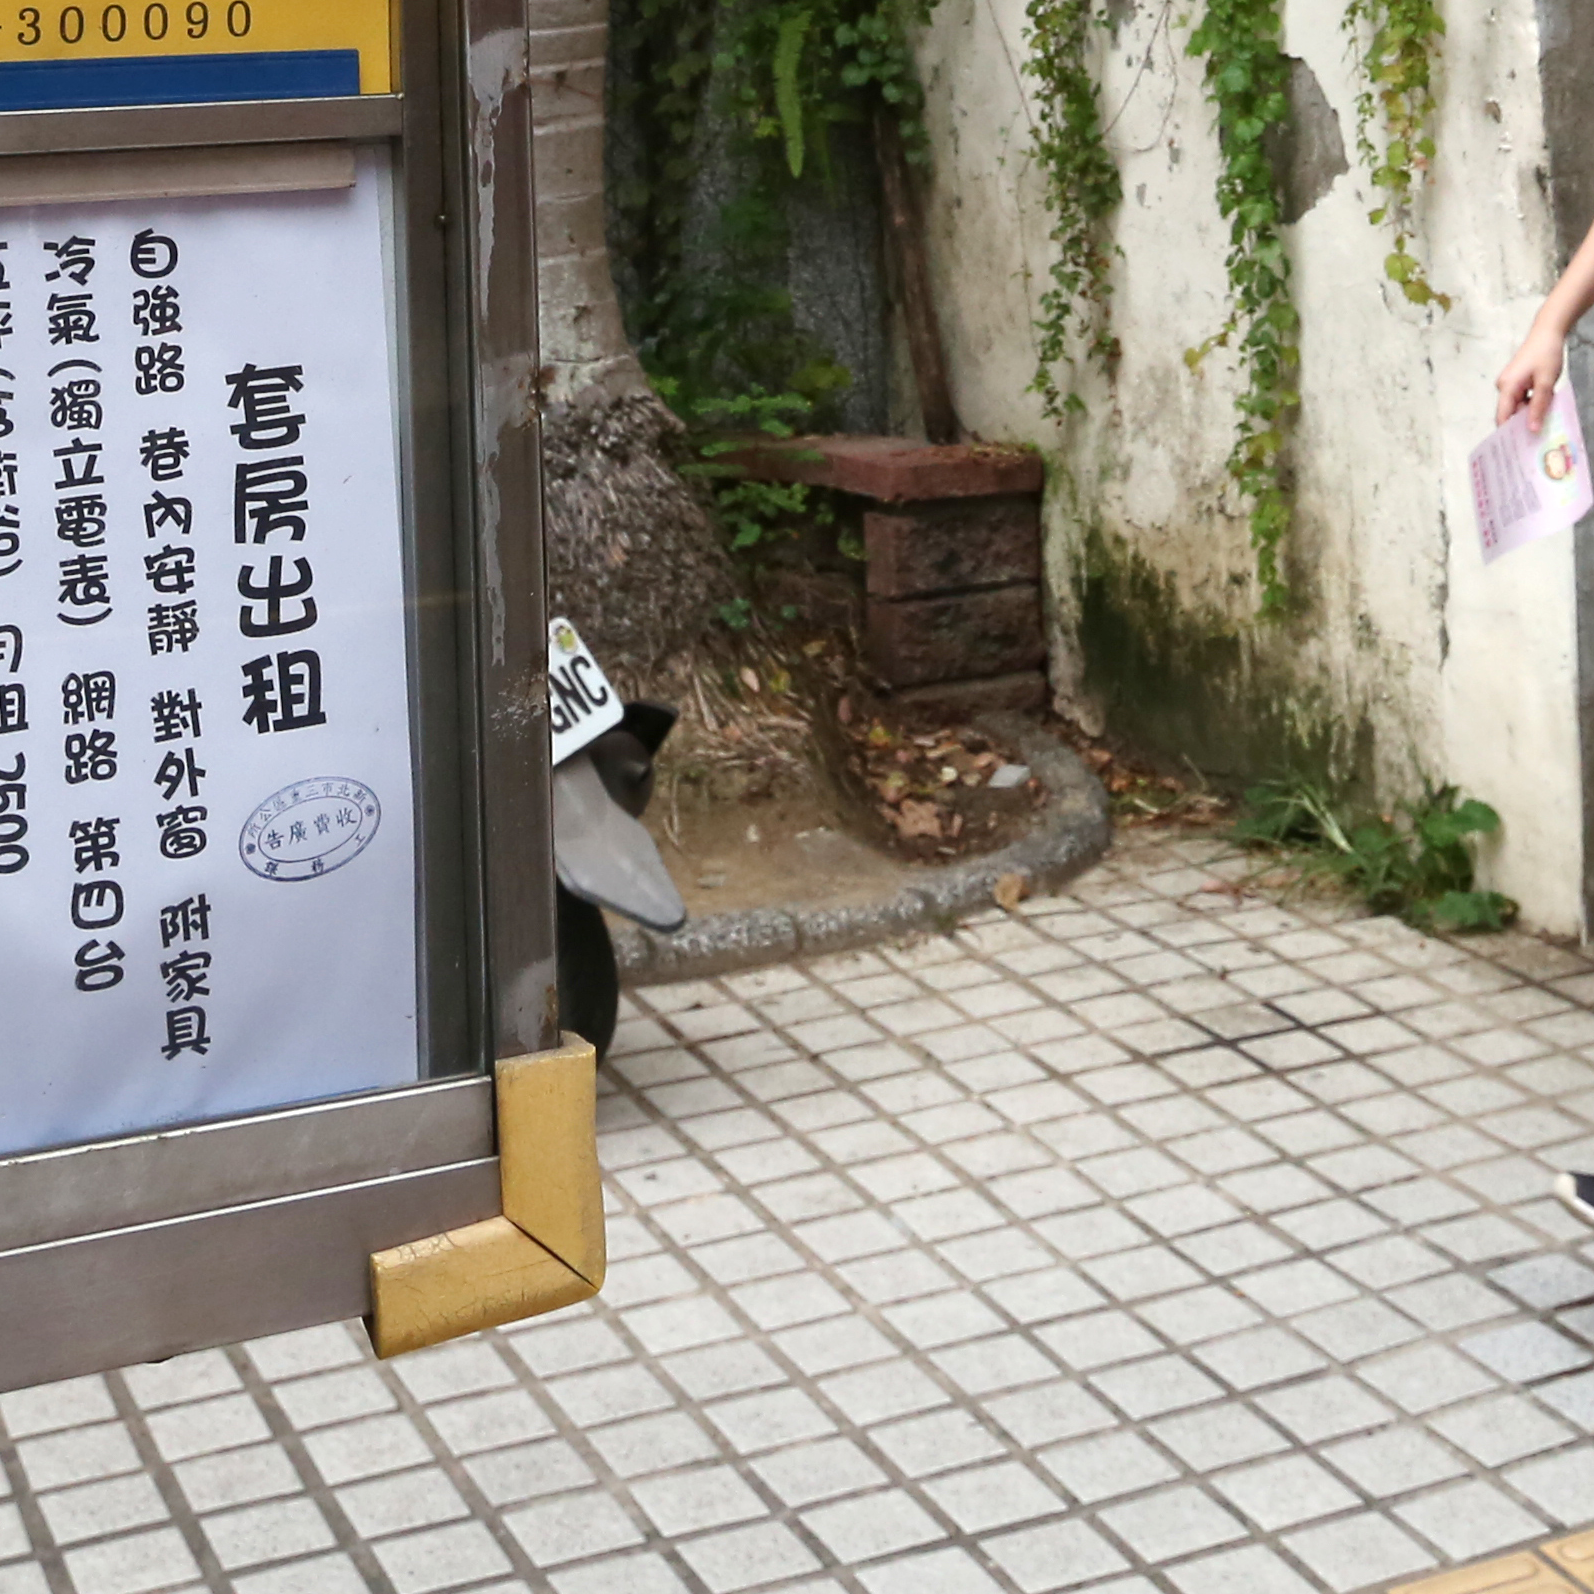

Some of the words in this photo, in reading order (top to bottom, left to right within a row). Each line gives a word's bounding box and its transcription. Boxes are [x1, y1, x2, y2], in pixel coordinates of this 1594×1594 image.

[129, 227, 186, 397] 自強路
[138, 427, 201, 657] 巷內安靜
[225, 362, 328, 736] 套房出租
[60, 670, 120, 787] 網路
[149, 687, 209, 861] 對外窗
[68, 815, 126, 994] 第四台
[158, 894, 212, 1062] 附家具
